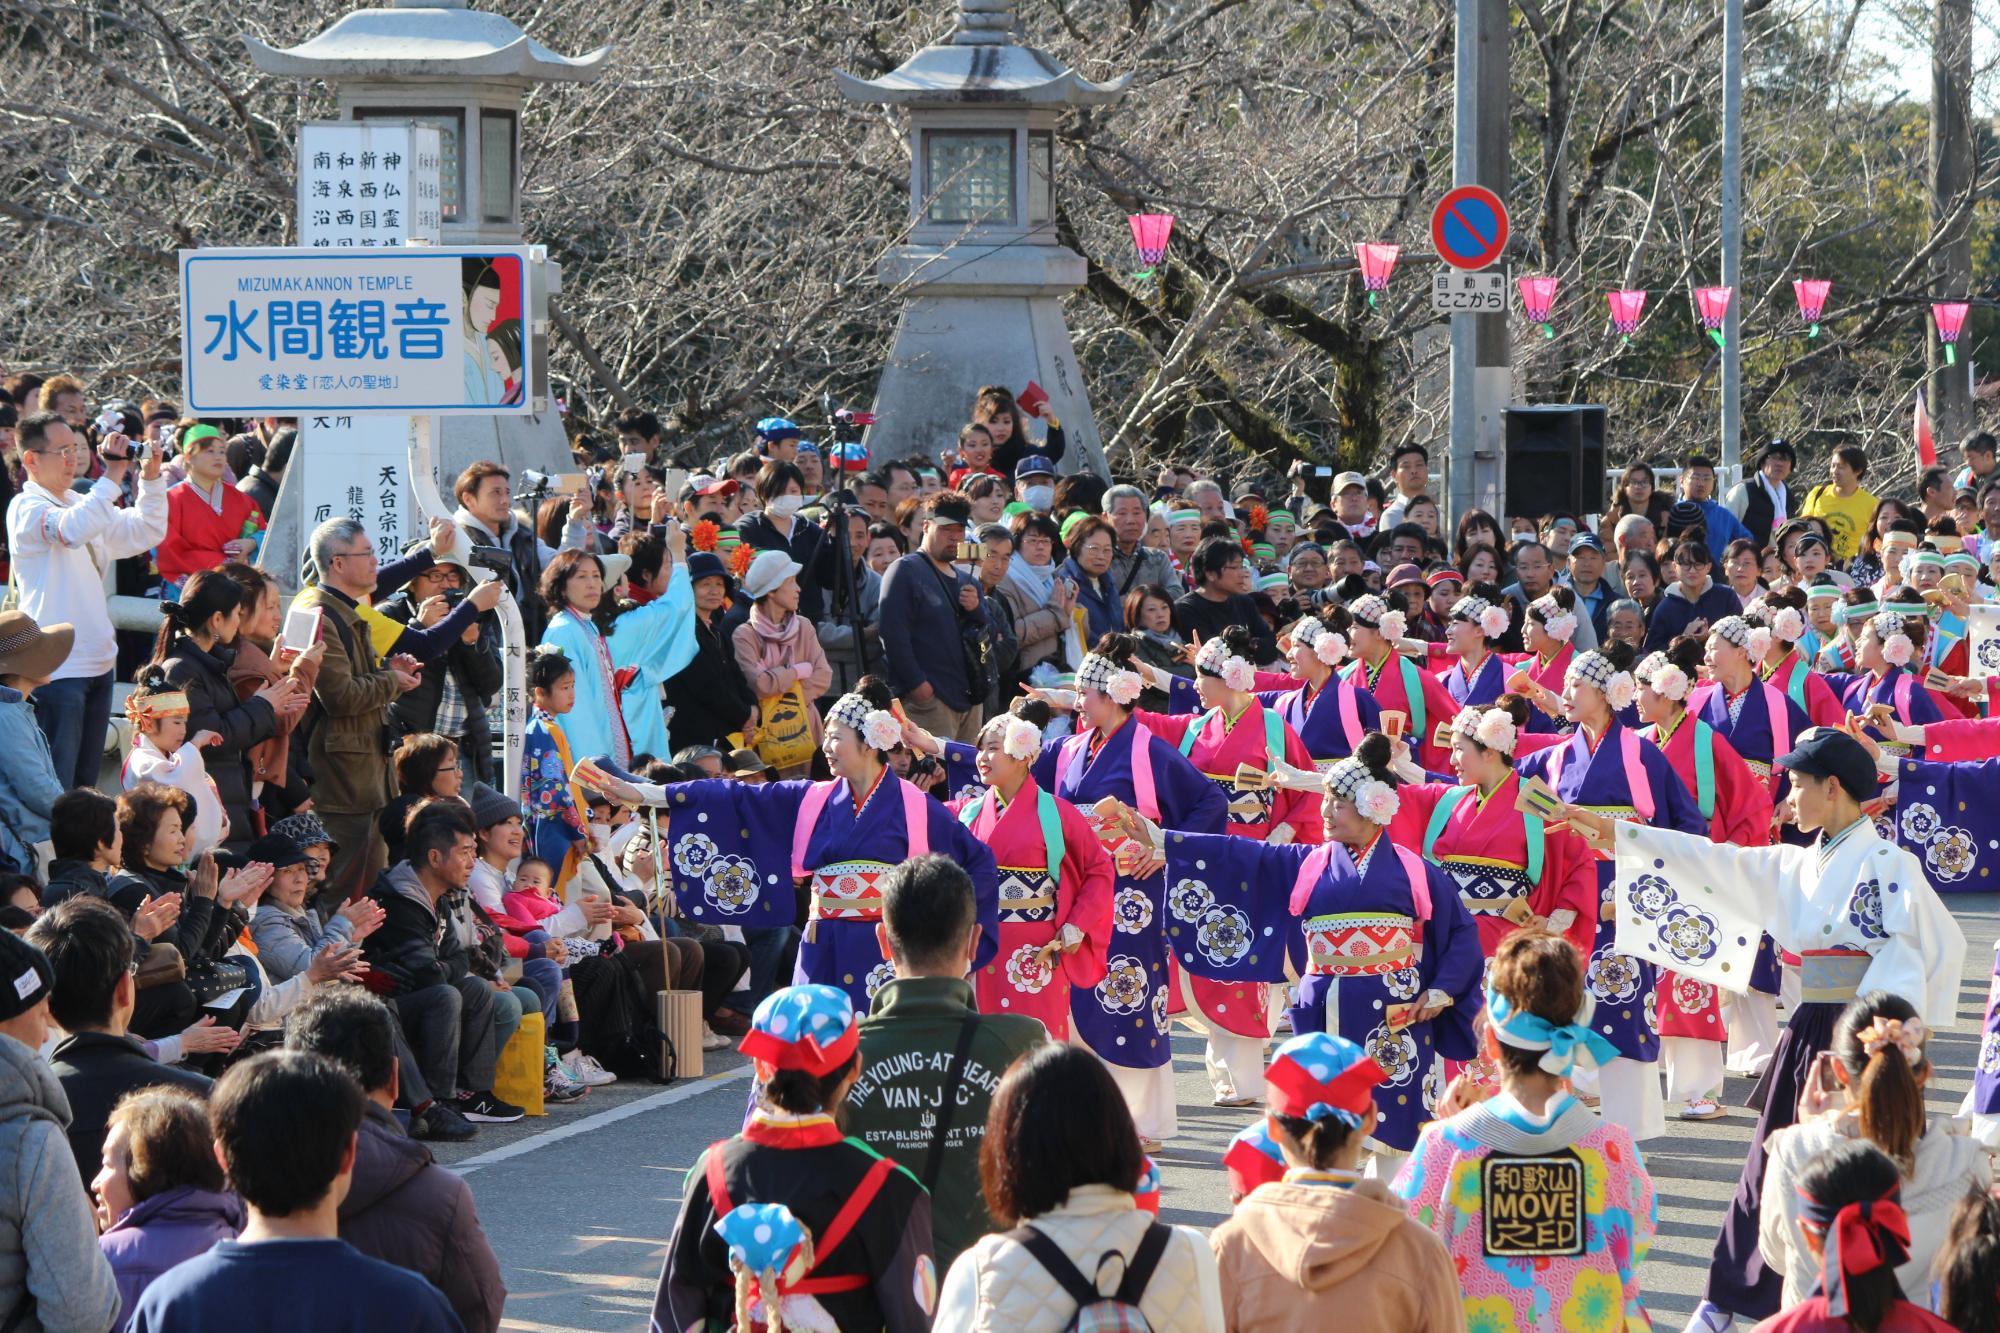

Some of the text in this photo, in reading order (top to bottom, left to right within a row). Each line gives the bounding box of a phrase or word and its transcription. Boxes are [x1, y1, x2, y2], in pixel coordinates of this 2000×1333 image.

[237, 276, 413, 292] MIZUMAKANNON TEMPLE
[1437, 276, 1502, 289] 自動車
[1437, 291, 1502, 308] ここから
[203, 298, 451, 361] 水間観音
[847, 1076, 875, 1108] THE
[964, 1125, 986, 1138] 194
[896, 1141, 929, 1149] FASHION
[1494, 1165, 1573, 1193] 和歌山
[1492, 1193, 1575, 1219] MOVE
